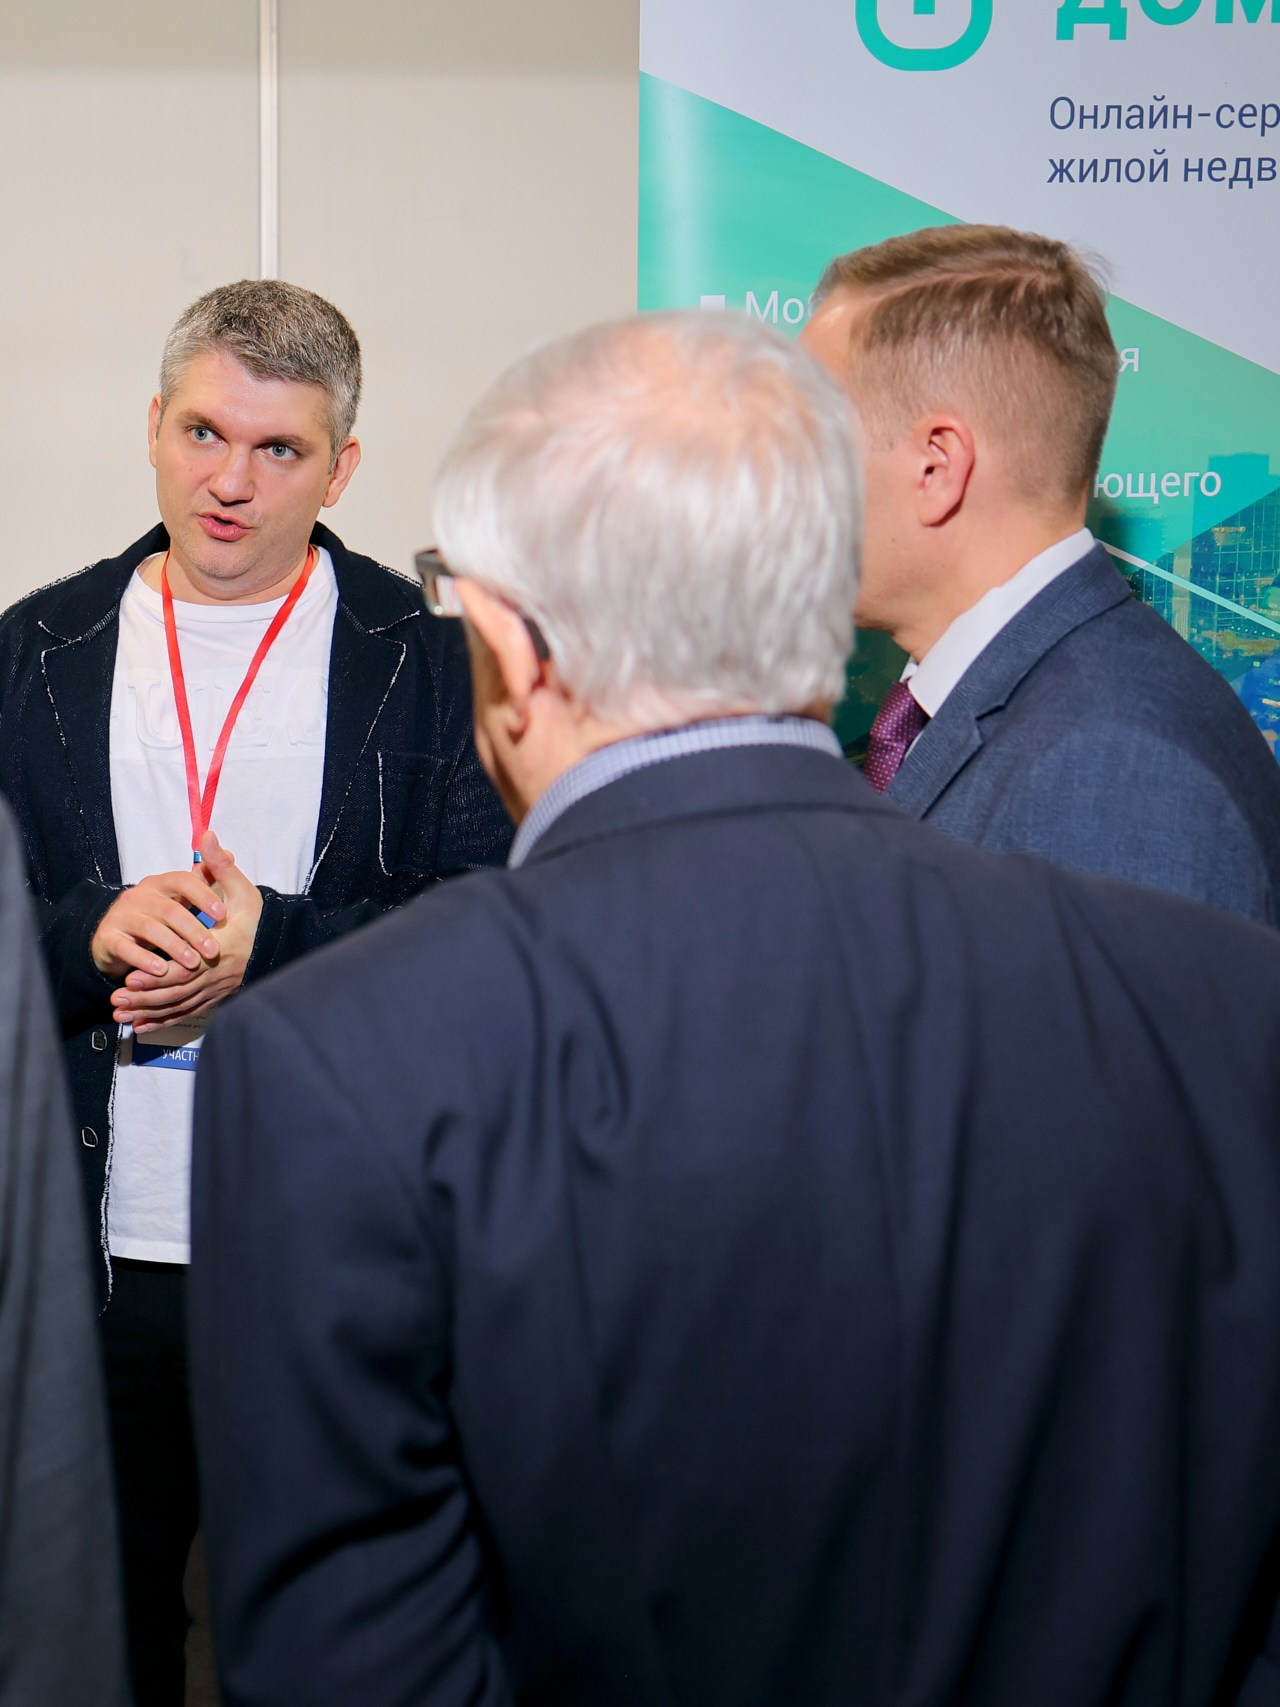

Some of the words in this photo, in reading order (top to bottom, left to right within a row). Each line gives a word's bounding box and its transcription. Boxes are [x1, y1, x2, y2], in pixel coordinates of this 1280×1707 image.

[1049, 94, 1280, 137] Онлайн-сер
[1046, 148, 1169, 184] жилой
[1183, 157, 1277, 190] недв
